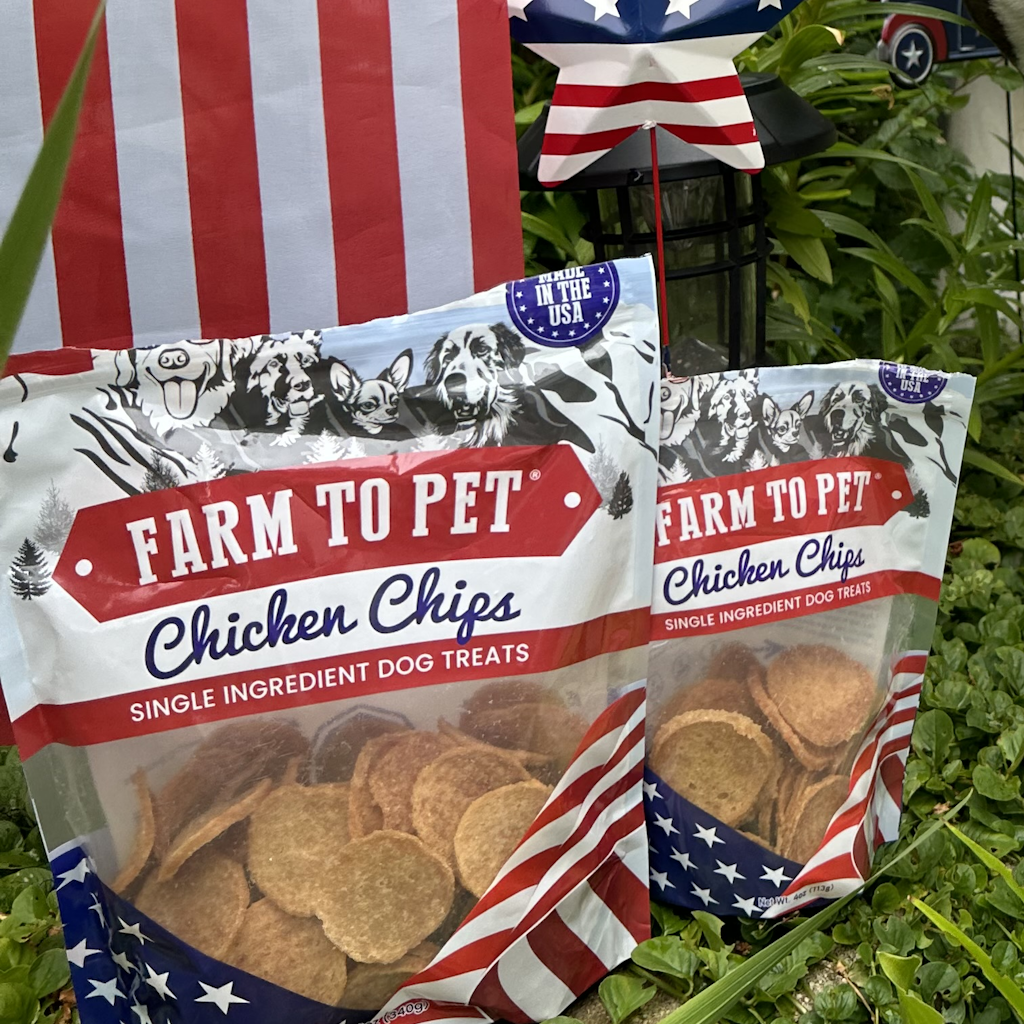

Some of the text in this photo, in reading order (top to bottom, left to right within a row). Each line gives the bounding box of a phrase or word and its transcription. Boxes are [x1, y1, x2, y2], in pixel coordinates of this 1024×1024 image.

[535, 277, 592, 307] IN THE
[548, 301, 584, 326] USA
[900, 379, 921, 393] USA
[126, 489, 298, 586] FARM
[316, 477, 390, 547] TO
[655, 485, 757, 547] FARM
[766, 476, 807, 523] TO
[663, 534, 865, 606] Chicken Chips
[145, 567, 521, 680] Chicken Chips
[664, 581, 871, 631] SINGLE INGREDIENT DOG TREATS
[130, 643, 530, 722] SINGLE INGREDIENT DOG TREATS
[809, 883, 835, 894] (113g)
[383, 1001, 430, 1023] (340g)
